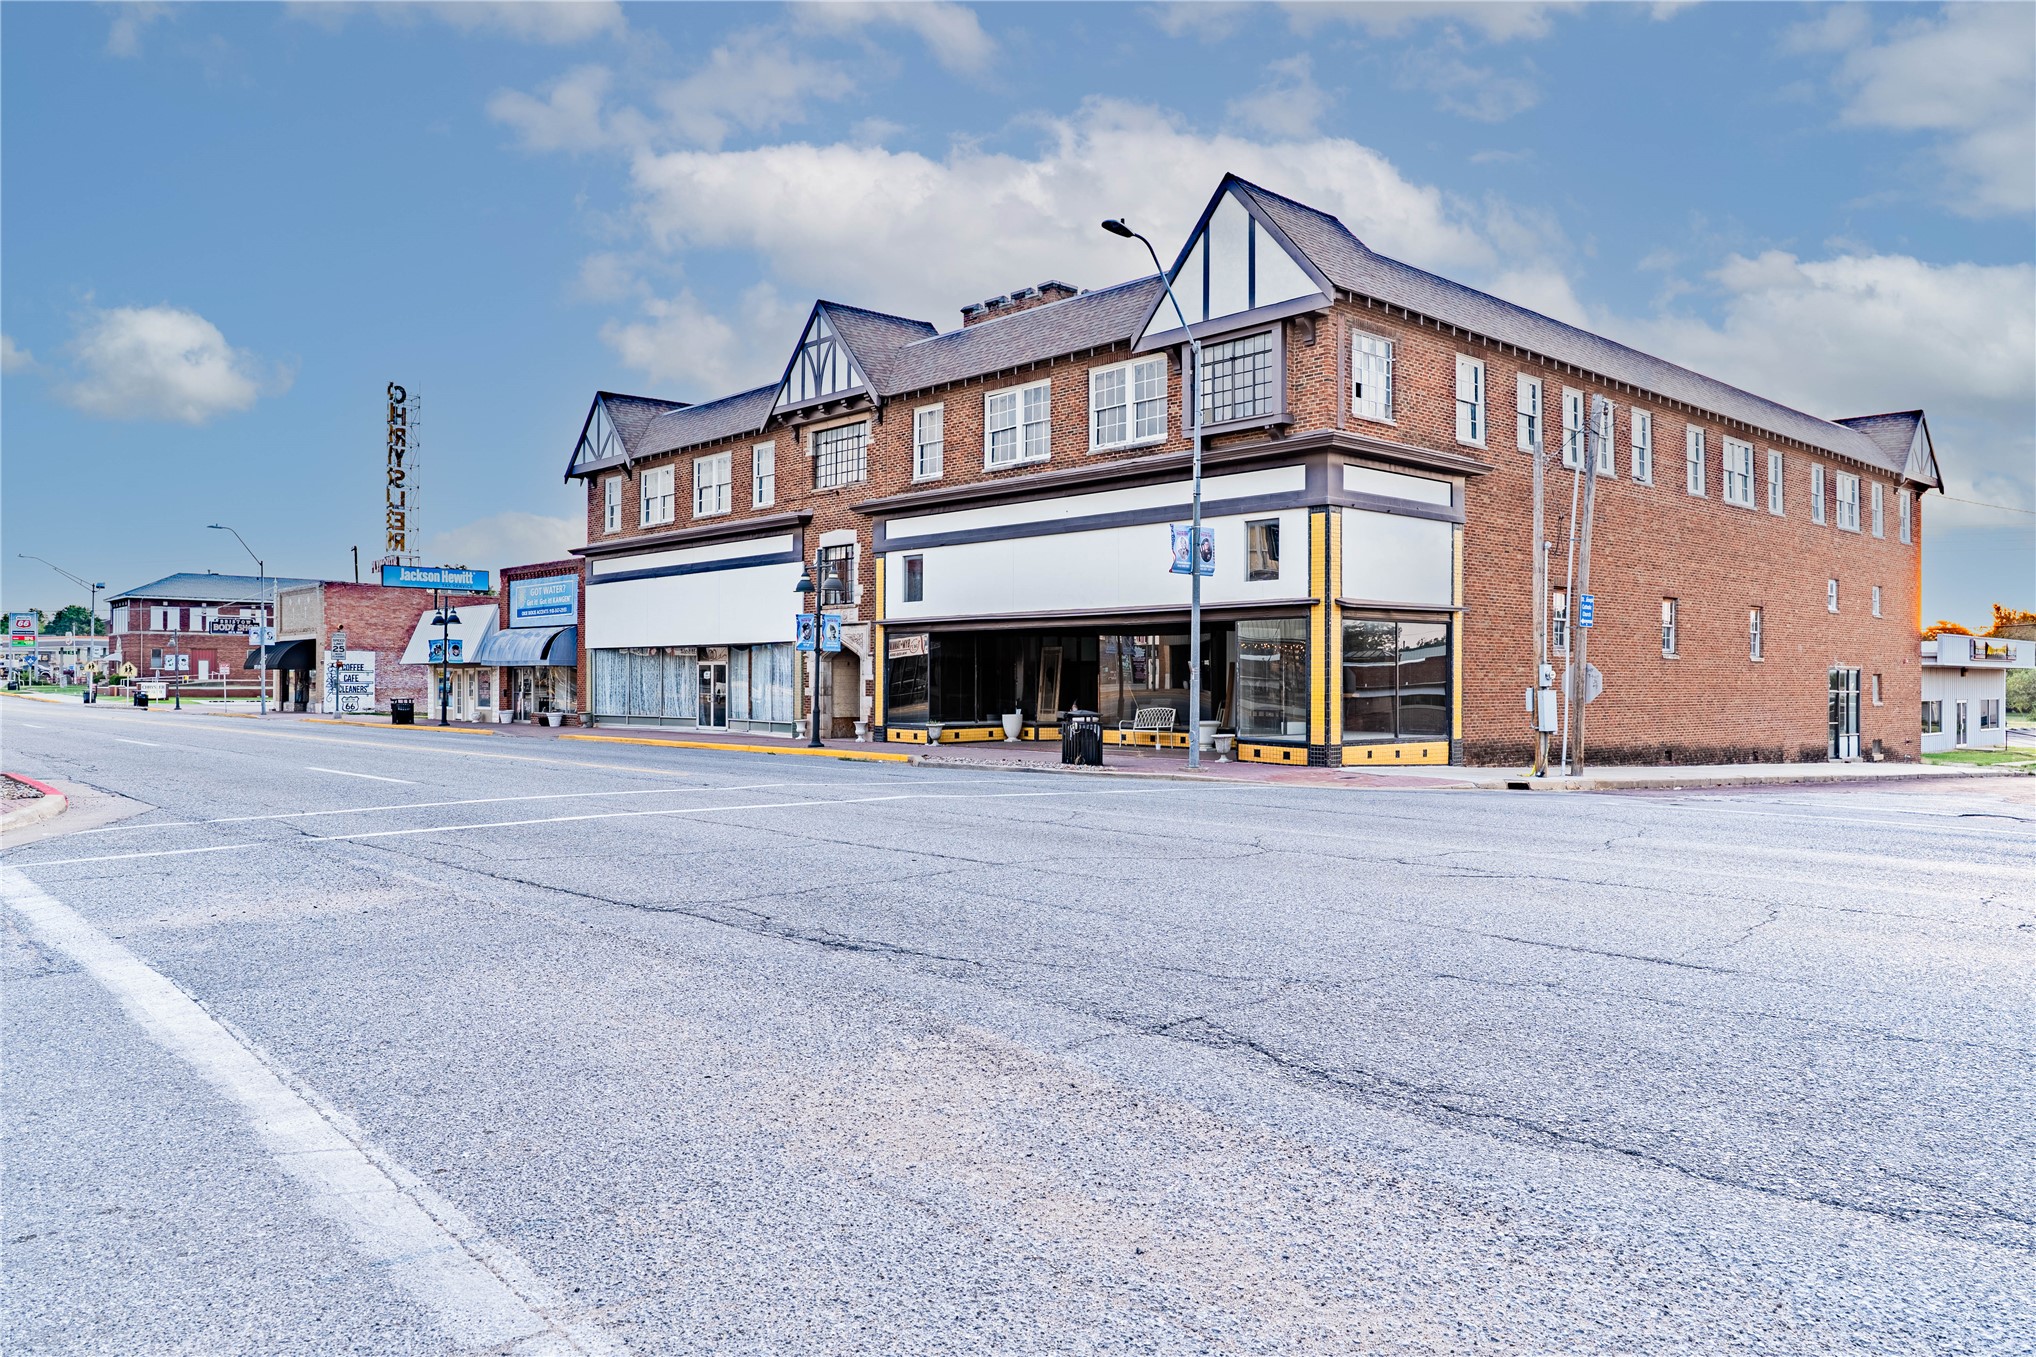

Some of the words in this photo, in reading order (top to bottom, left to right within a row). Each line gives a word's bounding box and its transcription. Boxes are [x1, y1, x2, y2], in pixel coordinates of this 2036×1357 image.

[400, 568, 440, 582] Jackson
[441, 570, 473, 584] Hewitt
[530, 587, 542, 596] GOT
[543, 585, 566, 595] WATER?
[343, 674, 359, 682] CAFE
